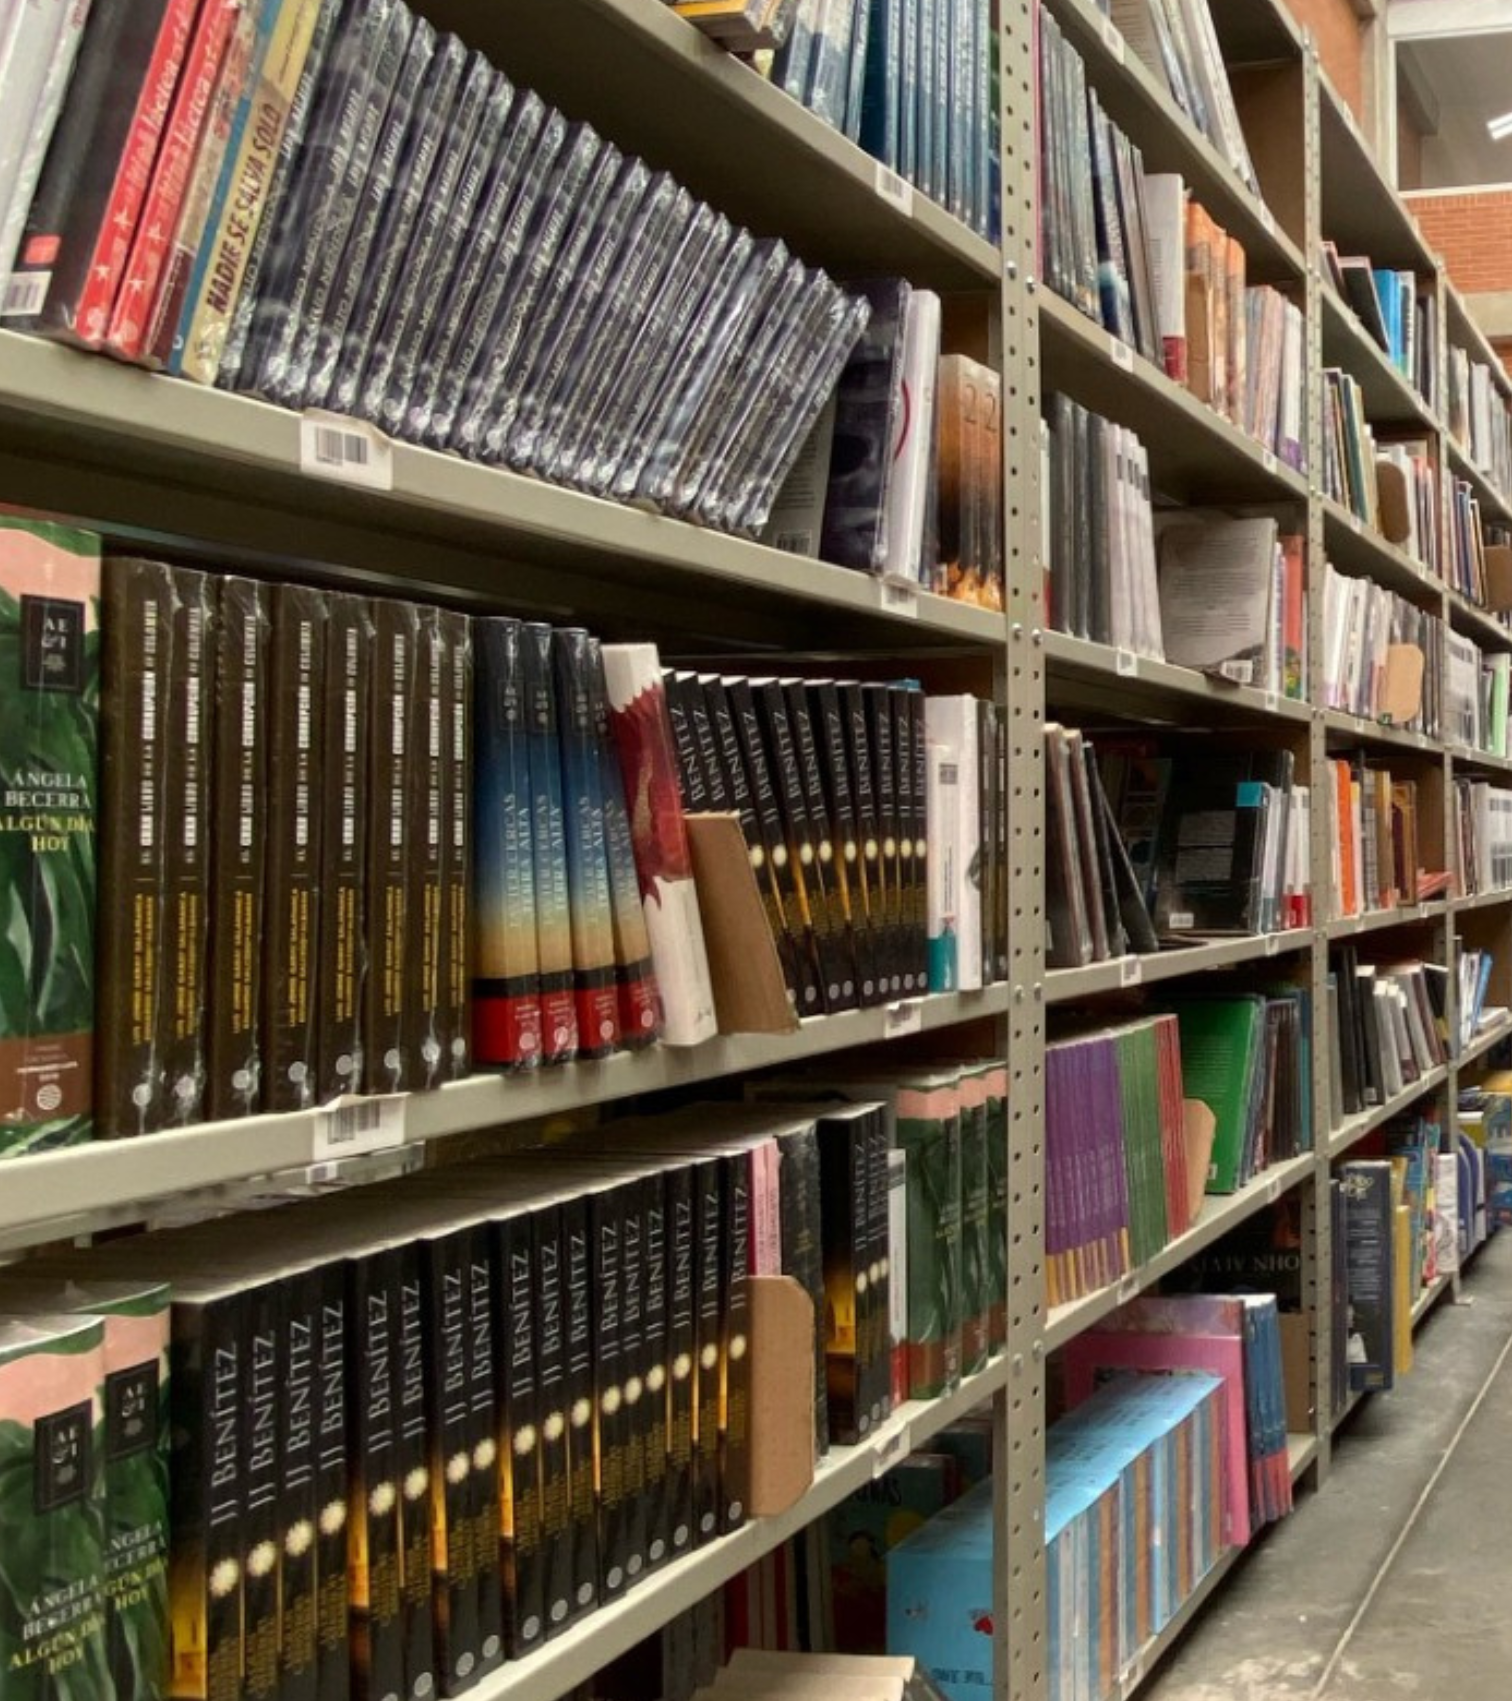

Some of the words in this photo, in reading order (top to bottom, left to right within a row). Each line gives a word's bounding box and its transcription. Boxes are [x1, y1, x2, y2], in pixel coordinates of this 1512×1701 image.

[253, 102, 283, 156] SOLO
[226, 204, 249, 246] SE
[233, 155, 269, 220] SALVA
[206, 240, 242, 315] NADIE
[4, 791, 91, 809] BECERRA
[13, 769, 88, 789] ÁNGELA
[441, 1267, 464, 1393] BENÍTEZ
[469, 1259, 492, 1380] BENÍTEZ
[508, 1249, 532, 1368] BENÍTEZ
[541, 1240, 561, 1355] BENÍTEZ
[568, 1229, 588, 1344] BENÍTEZ
[599, 1221, 619, 1333] BENÍTEZ
[285, 1315, 312, 1453] BENÍTEZ
[318, 1300, 344, 1435] BENÍTEZ
[365, 1290, 390, 1420] BENÍTEZ
[400, 1279, 424, 1406] BENÍTEZ
[210, 1341, 238, 1487] BENÍTEZ
[249, 1330, 276, 1472] BENÍTEZ
[109, 1520, 163, 1550] NGELA
